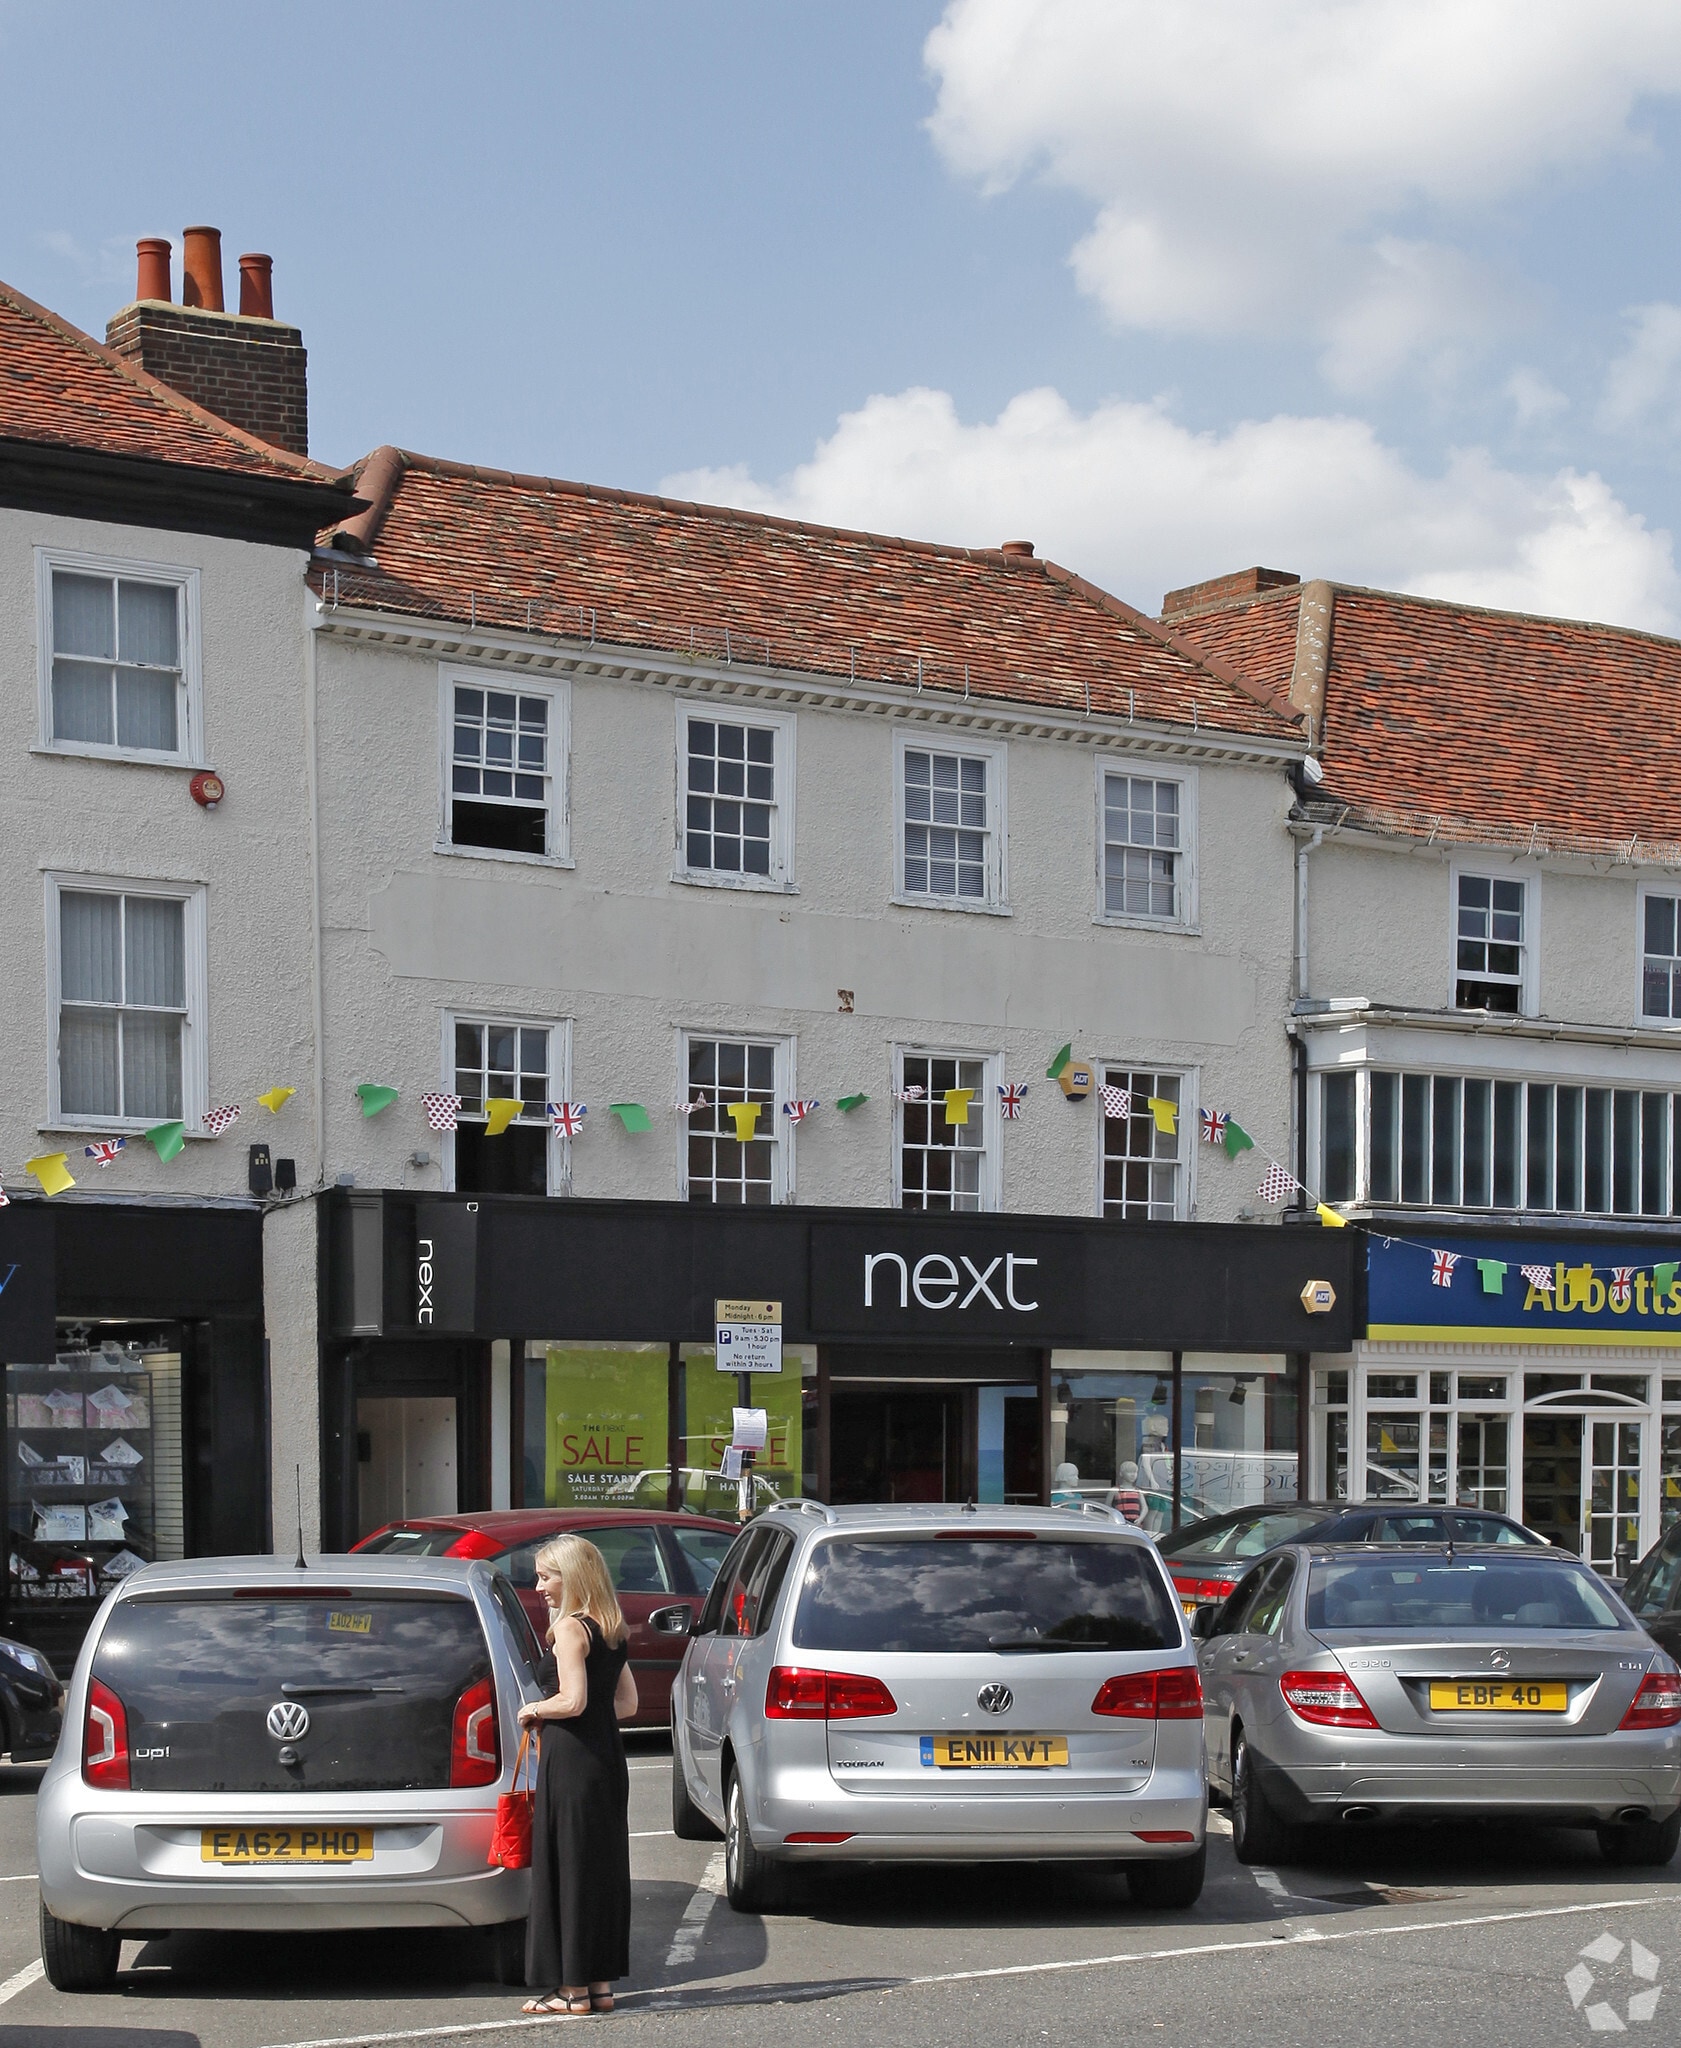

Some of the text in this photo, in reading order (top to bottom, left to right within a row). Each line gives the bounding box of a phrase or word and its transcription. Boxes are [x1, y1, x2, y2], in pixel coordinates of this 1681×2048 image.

[1073, 1074, 1088, 1084] ADT
[418, 1240, 433, 1324] next
[864, 1252, 1039, 1311] next
[1316, 1292, 1330, 1302] ADT
[583, 1424, 600, 1432] THE
[562, 1434, 644, 1466] SALE
[710, 1437, 787, 1467] SLE
[567, 1473, 596, 1484] SALE
[1360, 1660, 1392, 1668] 320
[1457, 1686, 1541, 1706] EBF 40
[136, 1746, 170, 1760] up!
[948, 1740, 1053, 1762] EN11 KVT
[836, 1760, 885, 1768] TOURAN
[213, 1832, 360, 1856] EA62 PHO
